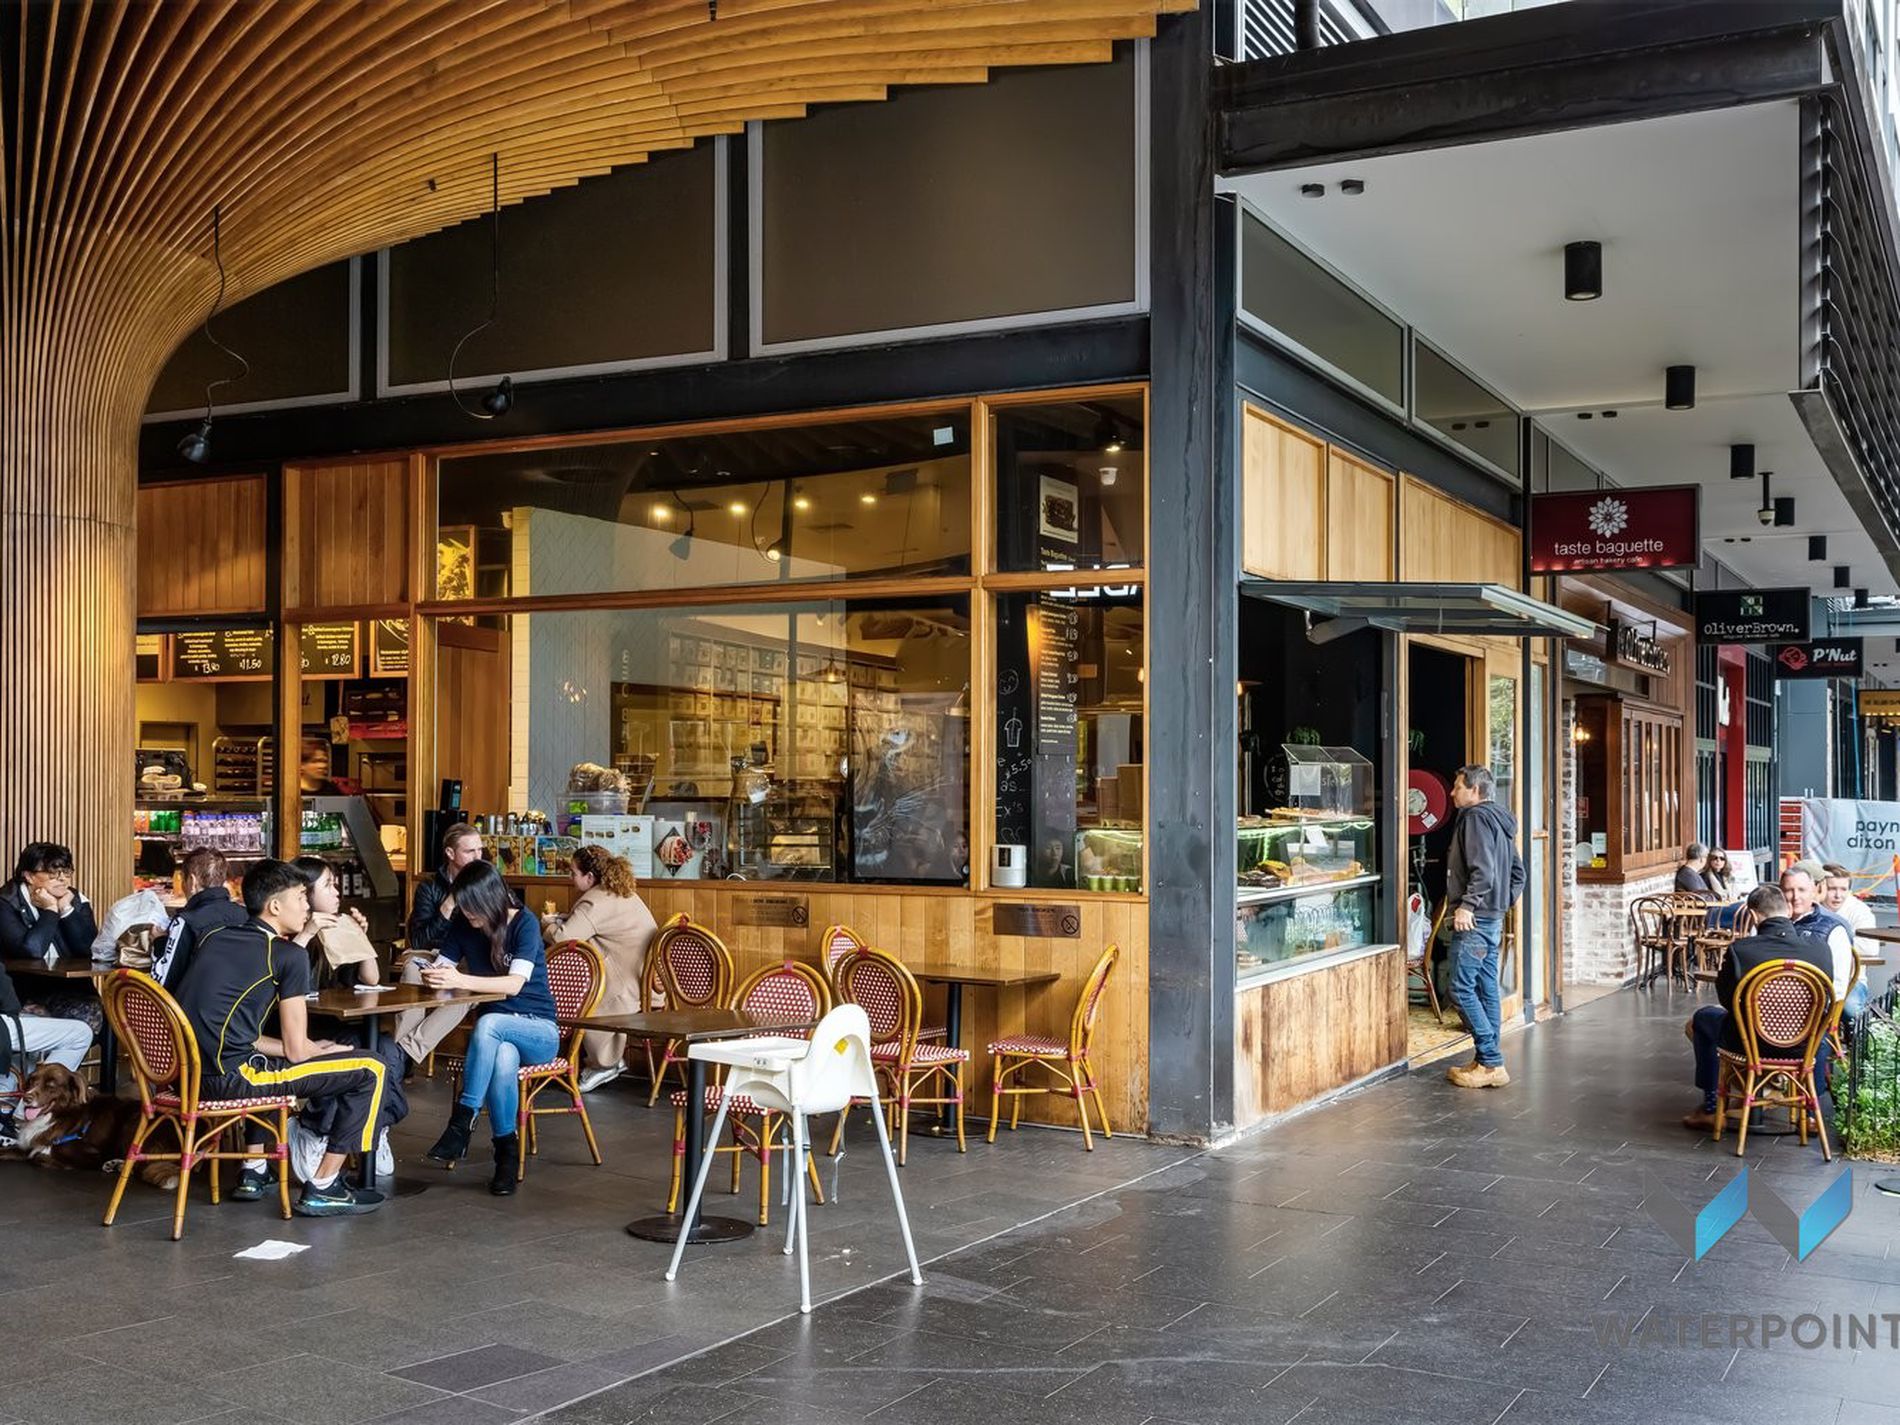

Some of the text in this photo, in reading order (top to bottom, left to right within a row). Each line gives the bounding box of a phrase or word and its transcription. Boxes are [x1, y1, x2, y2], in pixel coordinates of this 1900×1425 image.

[1554, 538, 1664, 556] taste baguette
[1812, 648, 1857, 662] P'Nut
[1847, 834, 1896, 850] dixon
